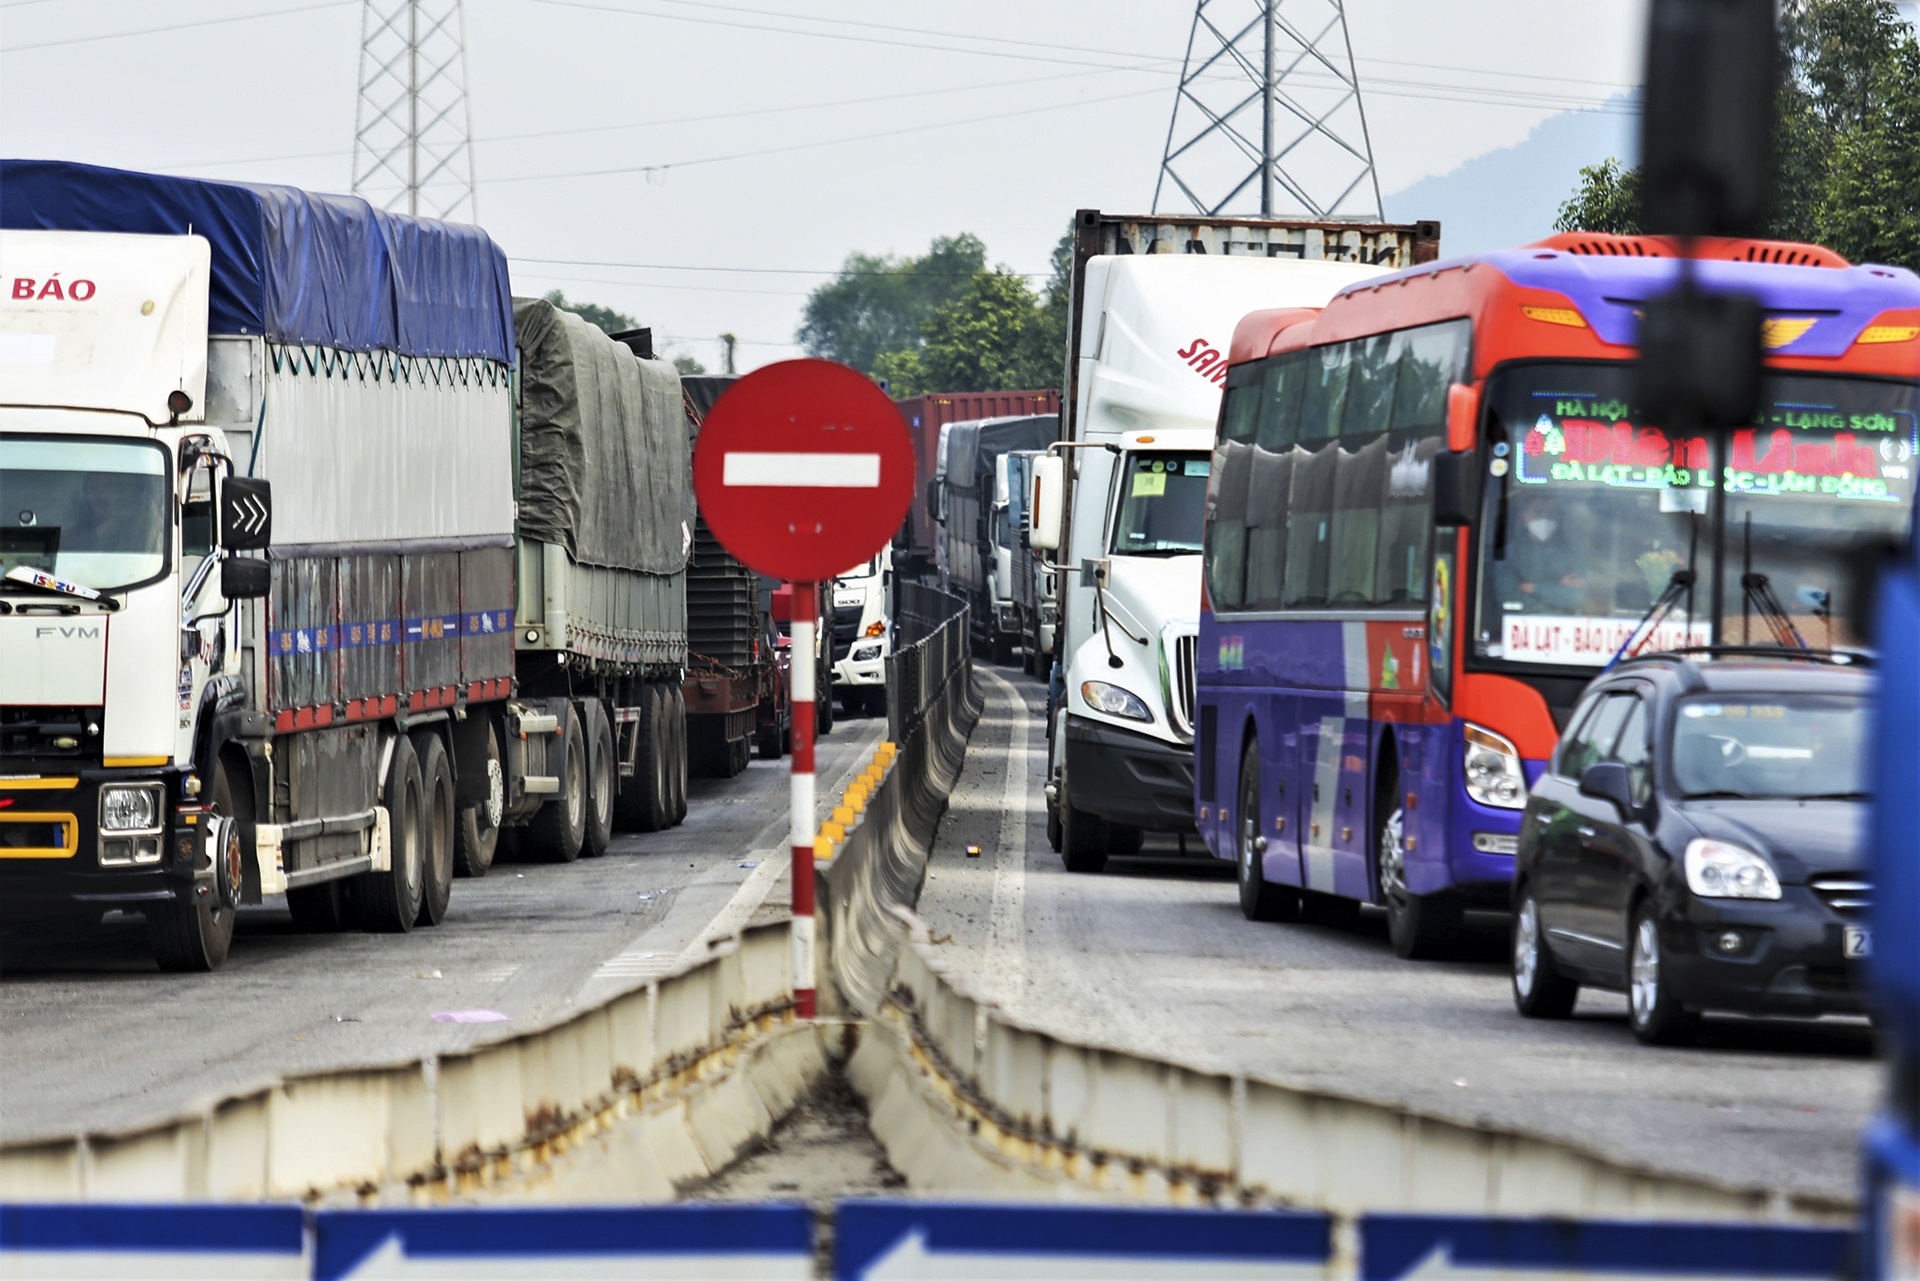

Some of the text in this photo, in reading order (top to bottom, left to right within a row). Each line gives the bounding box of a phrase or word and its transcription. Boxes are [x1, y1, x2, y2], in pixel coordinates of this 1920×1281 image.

[11, 272, 97, 302] BÁO
[1730, 427, 1878, 479] Linh
[33, 574, 76, 593] ISUZU
[36, 627, 99, 638] FVM
